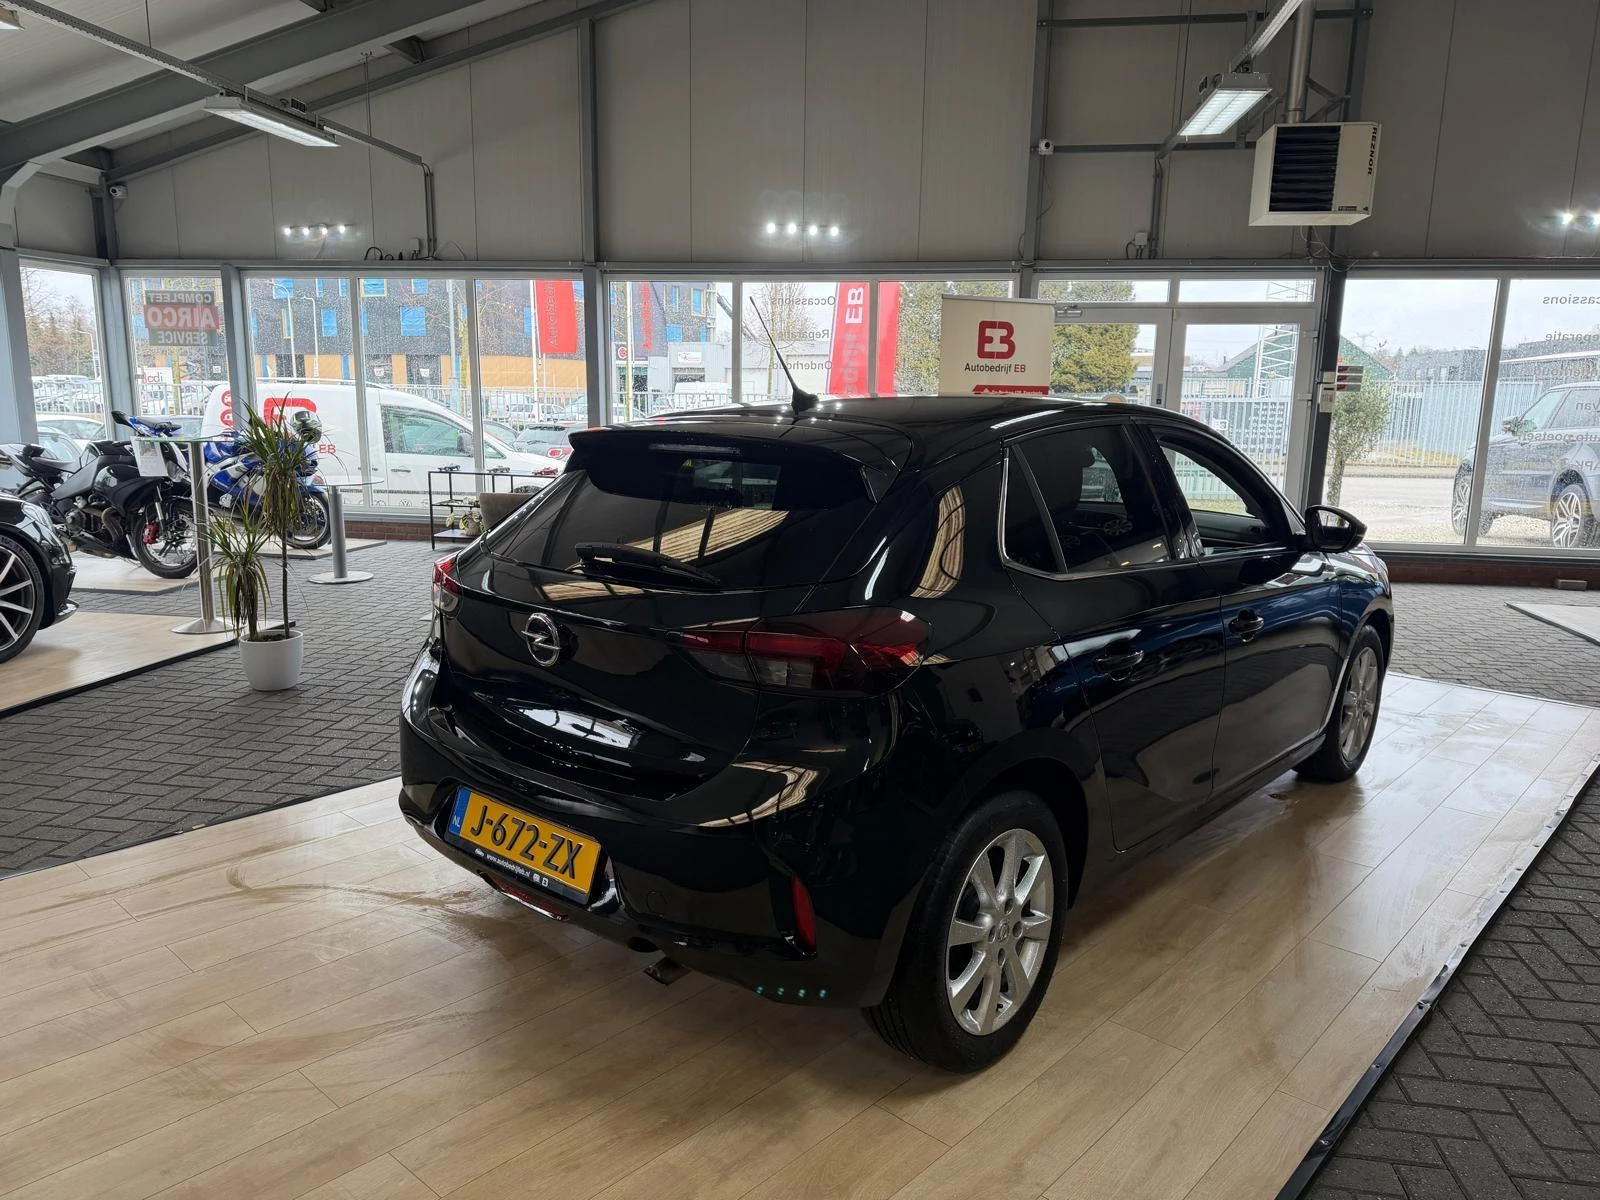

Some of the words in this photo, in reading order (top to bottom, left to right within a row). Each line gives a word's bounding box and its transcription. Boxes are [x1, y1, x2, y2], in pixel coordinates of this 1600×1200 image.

[1367, 127, 1378, 175] REZNOR
[844, 286, 865, 324] EB
[964, 362, 1012, 375] Autobedrijf
[1013, 364, 1026, 373] EB
[319, 444, 336, 454] EB
[452, 814, 461, 828] NL
[470, 805, 583, 880] J-672-ZX
